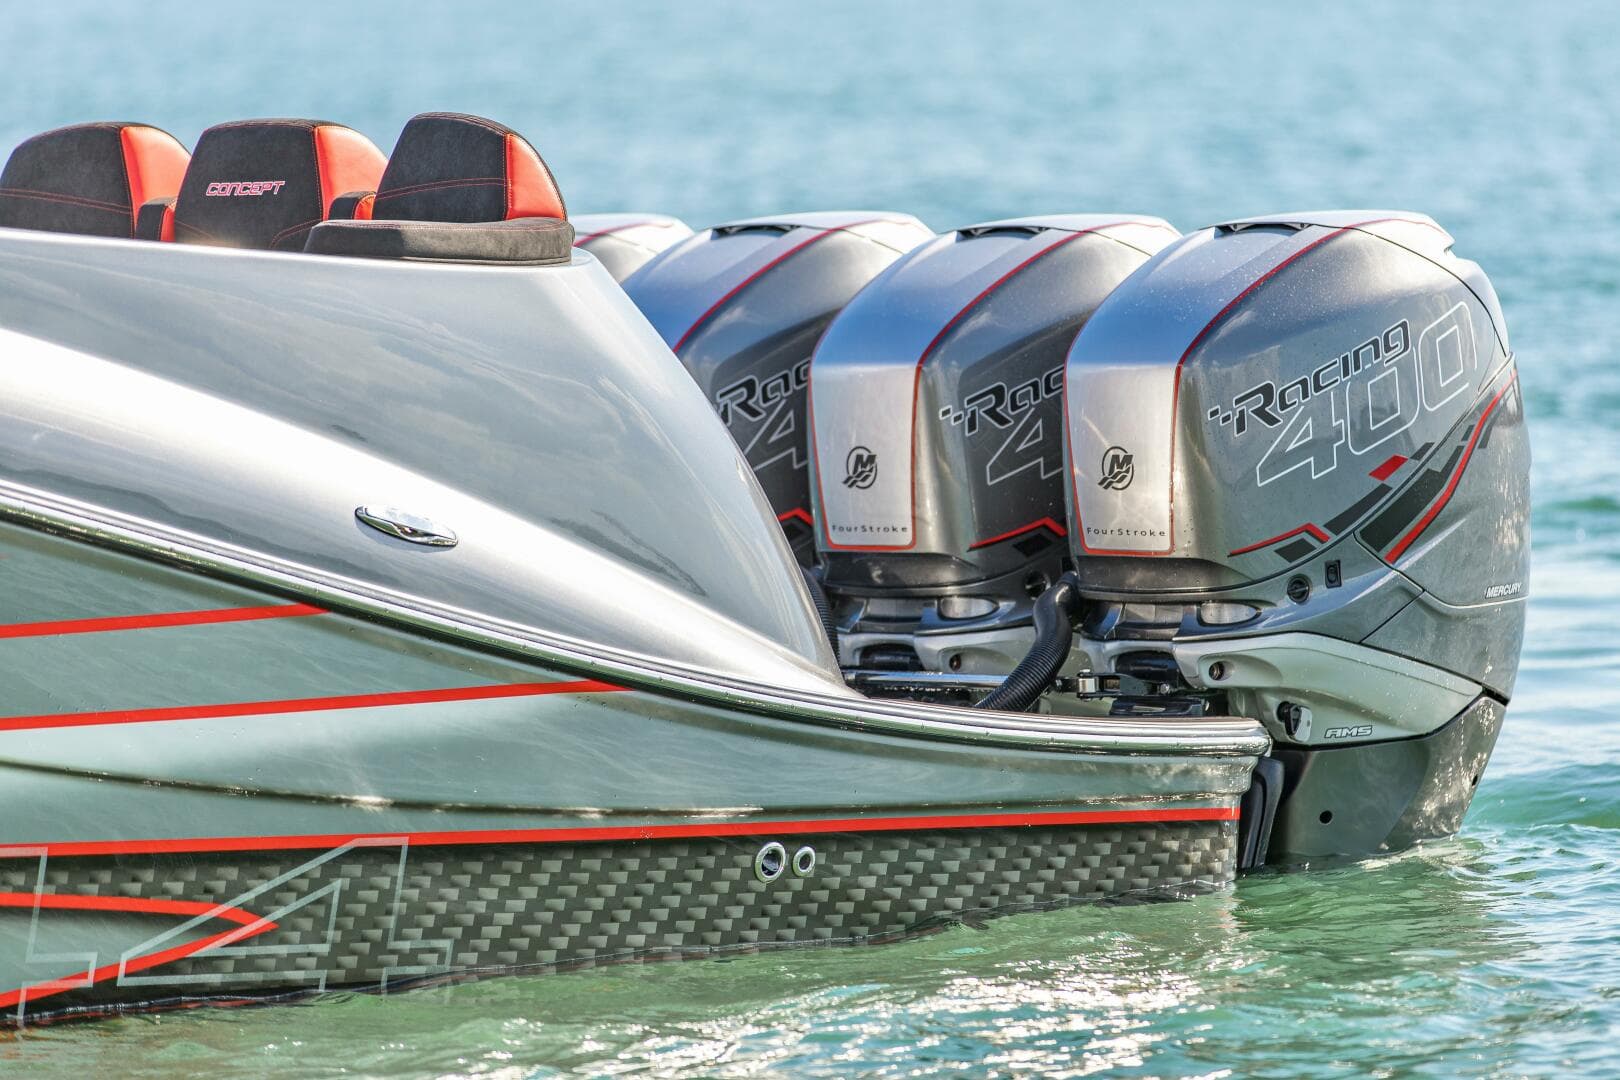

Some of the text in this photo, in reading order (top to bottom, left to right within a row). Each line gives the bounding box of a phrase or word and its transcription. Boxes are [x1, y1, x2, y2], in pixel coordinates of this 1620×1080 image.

[206, 181, 286, 196] CONCEPT
[1233, 318, 1410, 437] Racing
[1256, 301, 1478, 487] 400
[832, 524, 908, 533] FourStroke
[1087, 527, 1166, 537] FourStroke
[1485, 582, 1522, 599] MERCURY
[1324, 725, 1373, 739] AMS
